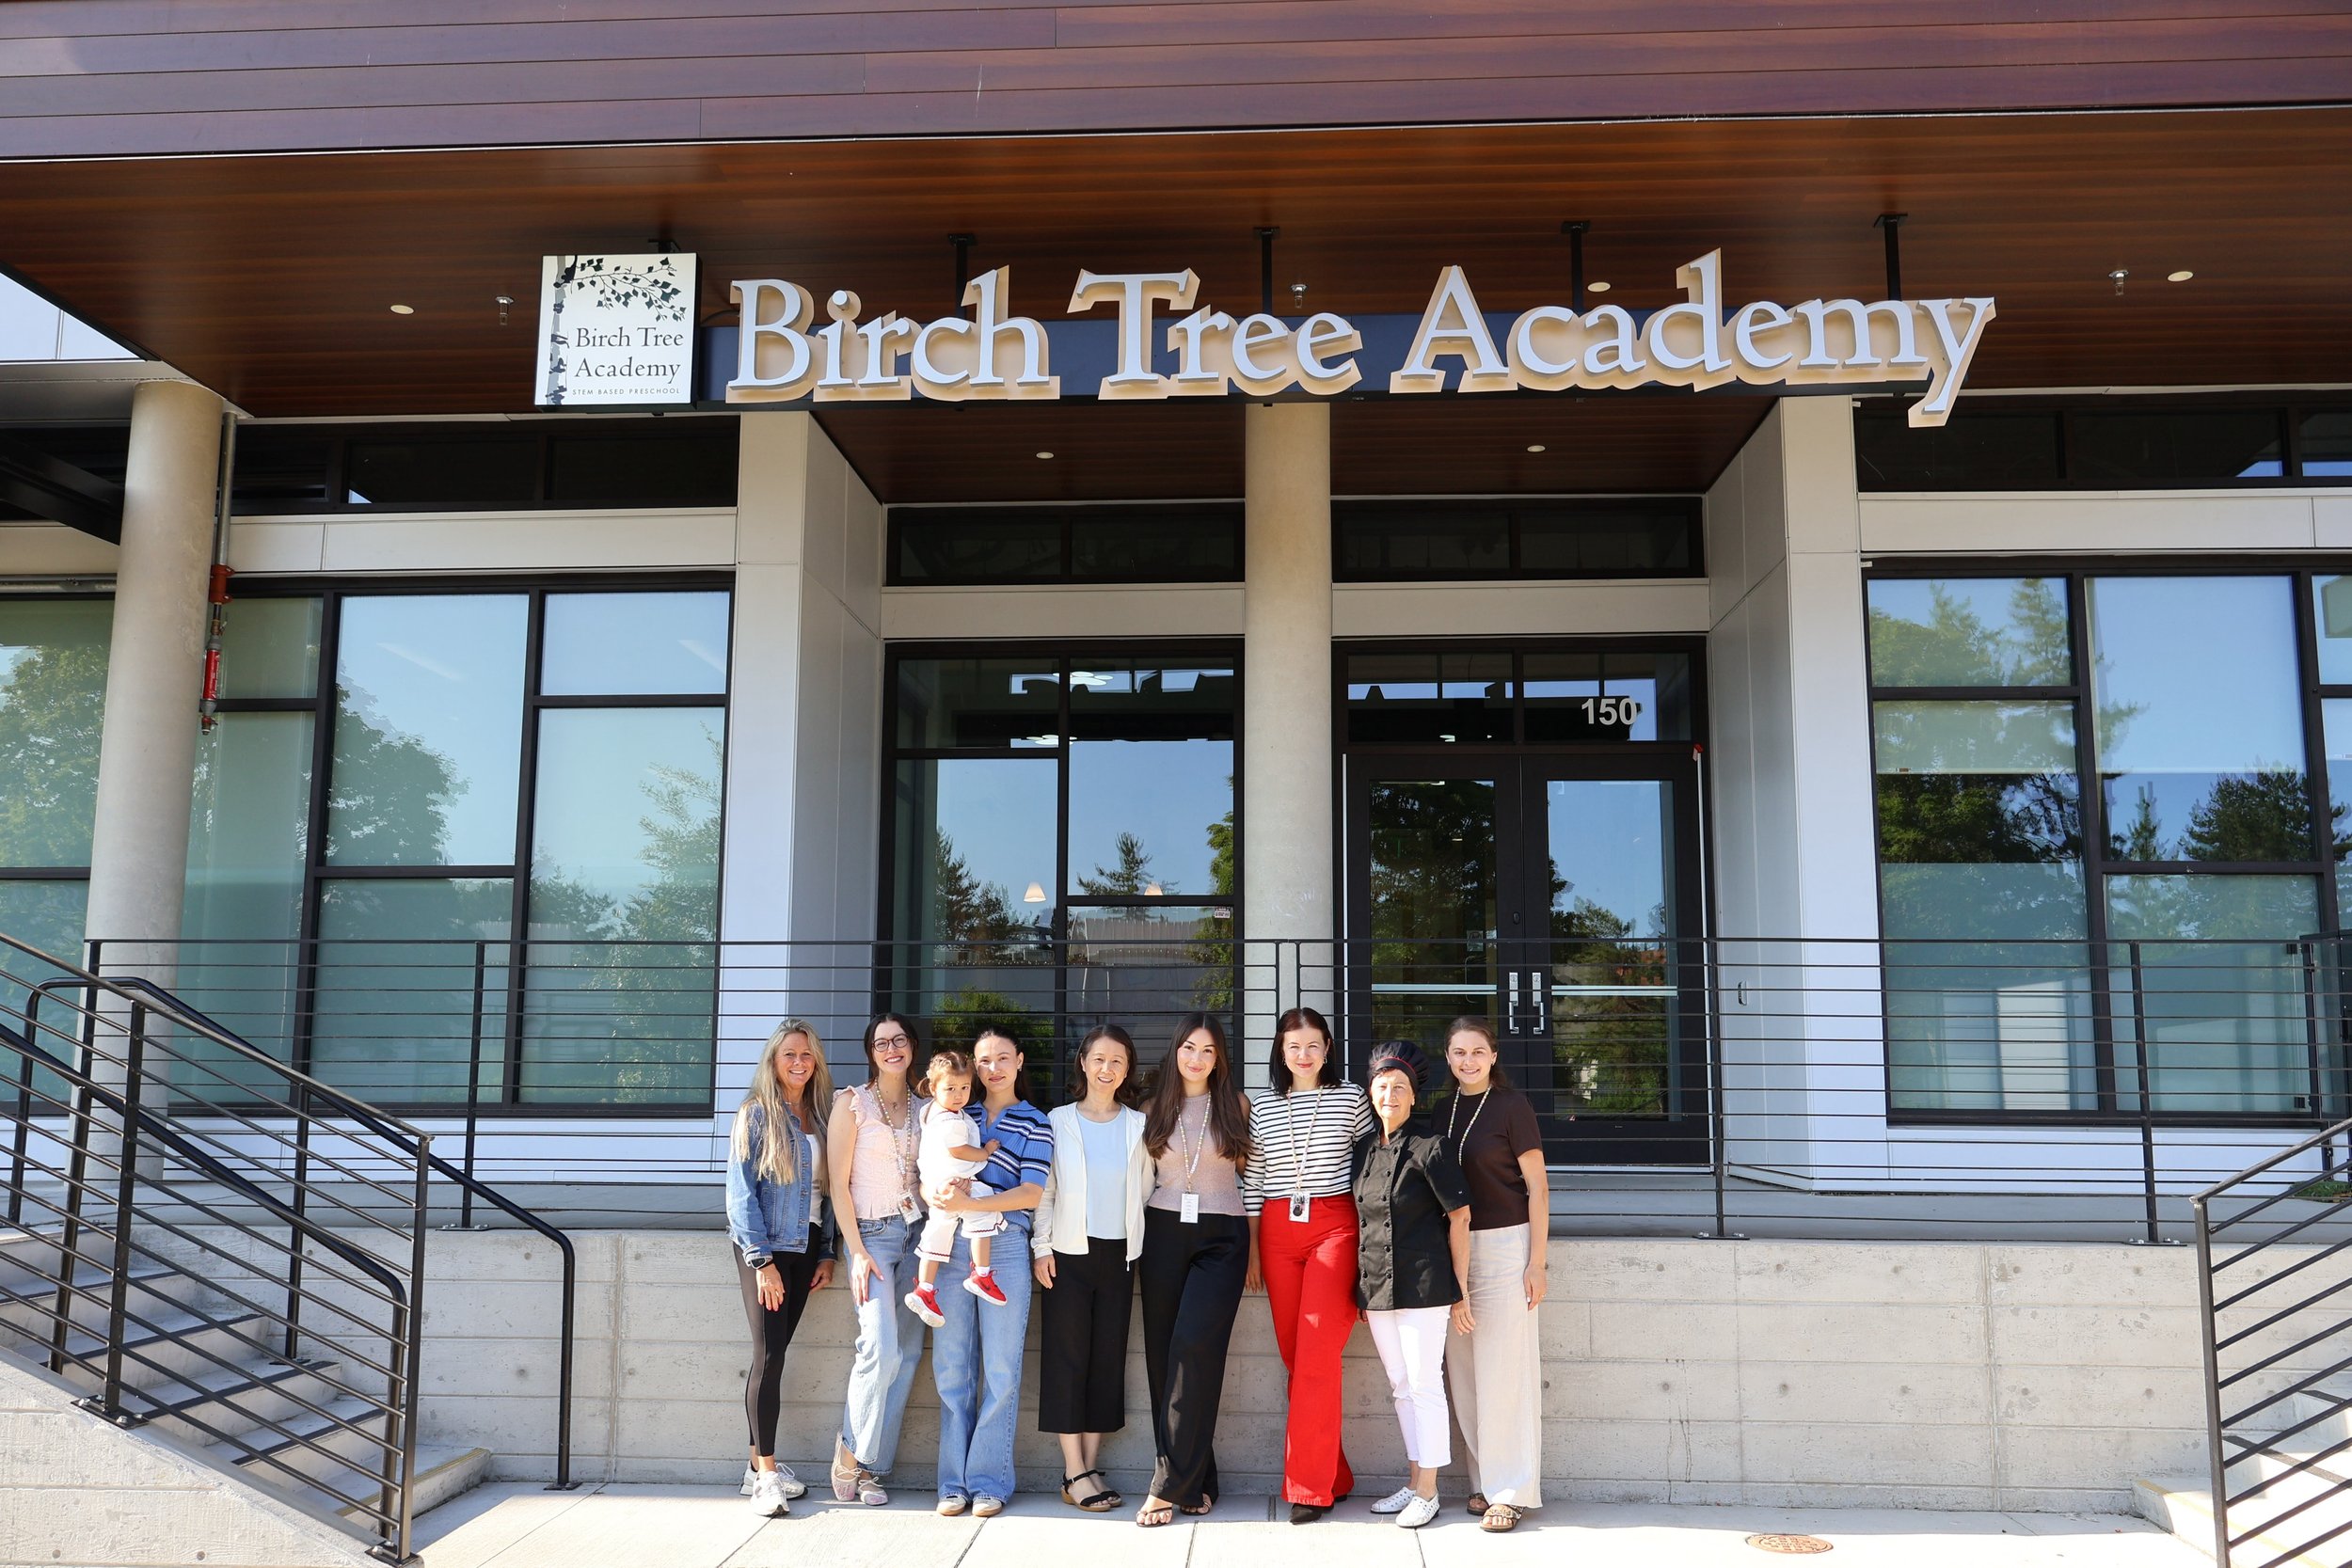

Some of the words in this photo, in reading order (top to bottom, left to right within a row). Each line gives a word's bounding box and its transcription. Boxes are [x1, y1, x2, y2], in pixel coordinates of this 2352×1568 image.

[576, 326, 630, 347] Birch
[637, 327, 684, 347] Tree
[725, 264, 1060, 404] Birch
[1067, 268, 1362, 400] Tree
[1390, 247, 1996, 428] Academy
[574, 356, 681, 384] Academy
[1581, 698, 1637, 725] 150
